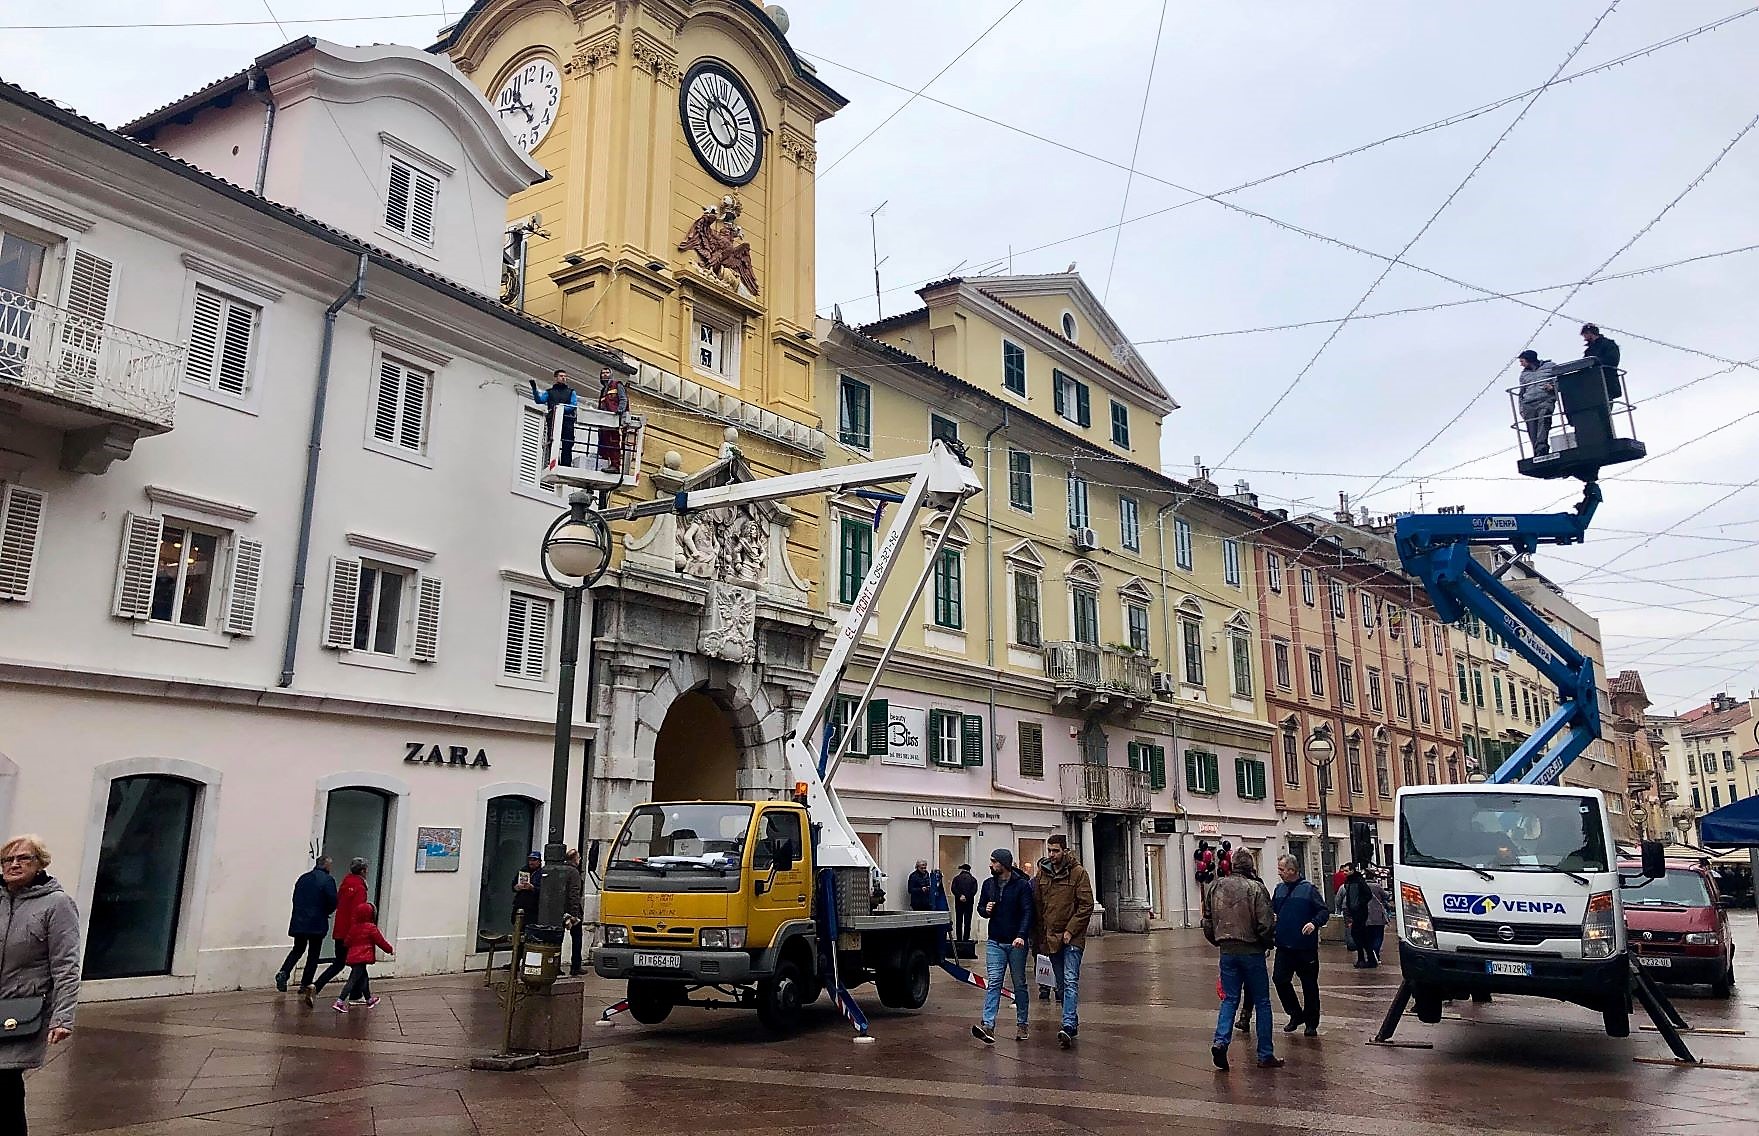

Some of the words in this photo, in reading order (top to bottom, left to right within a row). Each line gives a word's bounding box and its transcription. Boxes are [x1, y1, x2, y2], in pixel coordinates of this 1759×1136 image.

[524, 65, 536, 86] 12
[539, 65, 545, 84] 1
[544, 71, 554, 89] 2
[500, 87, 512, 107] 10
[548, 87, 558, 106] 3
[540, 107, 550, 125] 4
[530, 123, 541, 145] 5
[1494, 519, 1517, 528] VENPA
[855, 586, 873, 618] MONT
[1526, 634, 1551, 662] VENPA
[888, 721, 919, 747] Bliss
[404, 742, 491, 767] ZARA
[1444, 895, 1469, 908] GV3
[1502, 900, 1567, 914] VENPA
